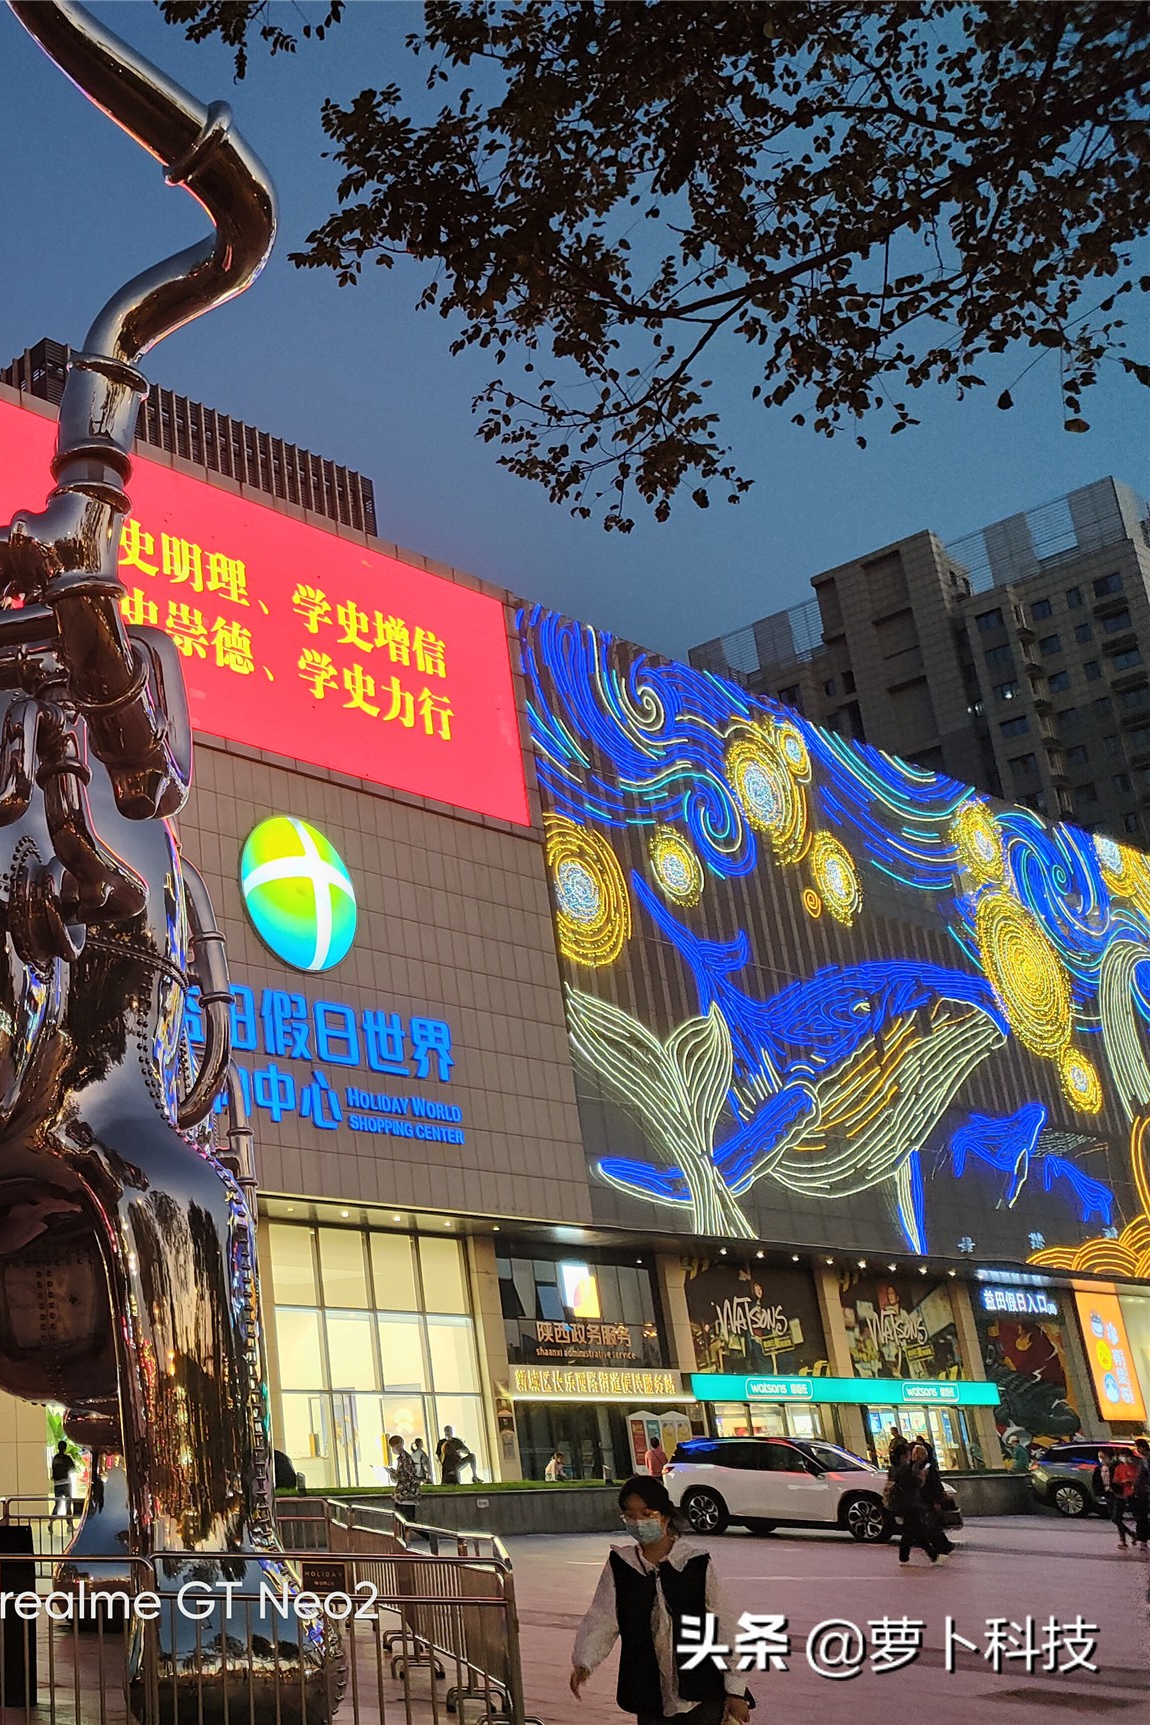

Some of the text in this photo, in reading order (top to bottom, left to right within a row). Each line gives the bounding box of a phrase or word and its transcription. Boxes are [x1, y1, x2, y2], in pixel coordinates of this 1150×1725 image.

[345, 1086, 463, 1123] HOLIDAY WORLD
[348, 1114, 465, 1145] SHOPPING CENTER
[535, 1321, 632, 1347] 陕西政务服务
[536, 1347, 637, 1360] shaanxi administrative service
[750, 1382, 788, 1394] watsons
[906, 1386, 938, 1398] watsons
